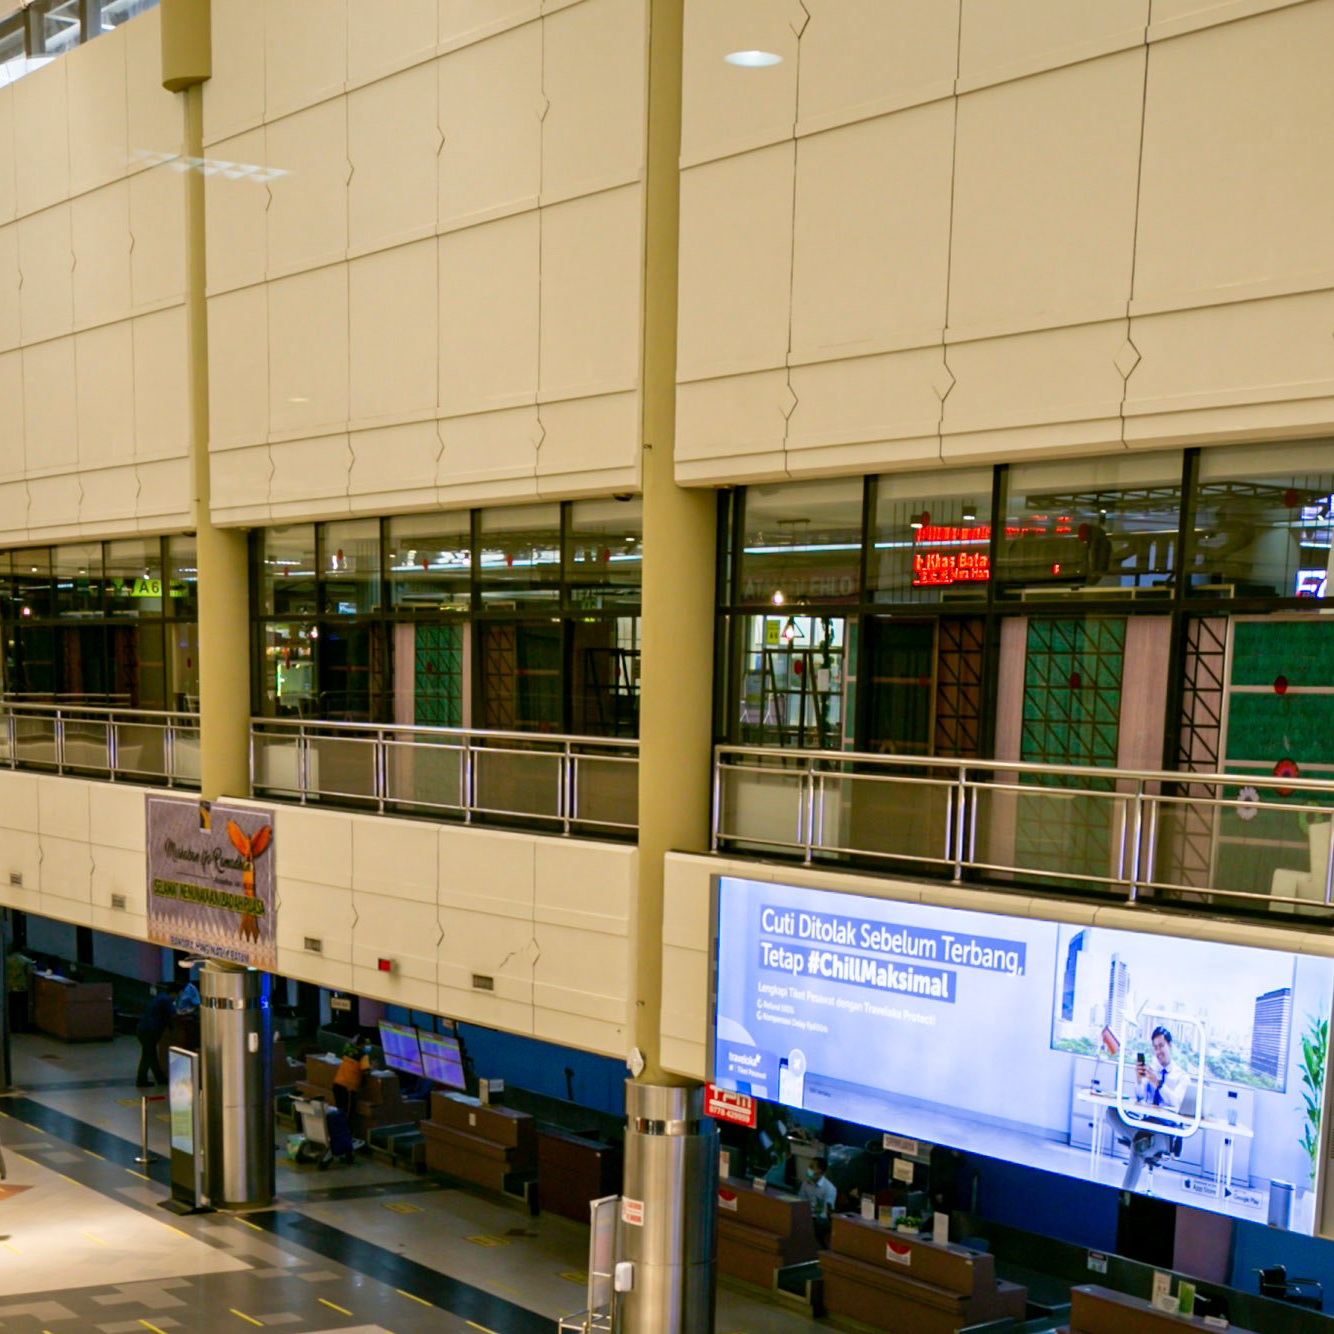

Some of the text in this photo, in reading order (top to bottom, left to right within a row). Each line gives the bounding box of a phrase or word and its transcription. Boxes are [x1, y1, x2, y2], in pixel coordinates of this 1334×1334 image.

[760, 942, 950, 998] Tetap #ChillMaksimal
[762, 907, 1025, 978] Cuti Ditolak Sebelum Terbang,
[758, 981, 788, 999] Lengkapi
[835, 997, 863, 1013] dengan
[864, 1002, 902, 1020] Traveloka
